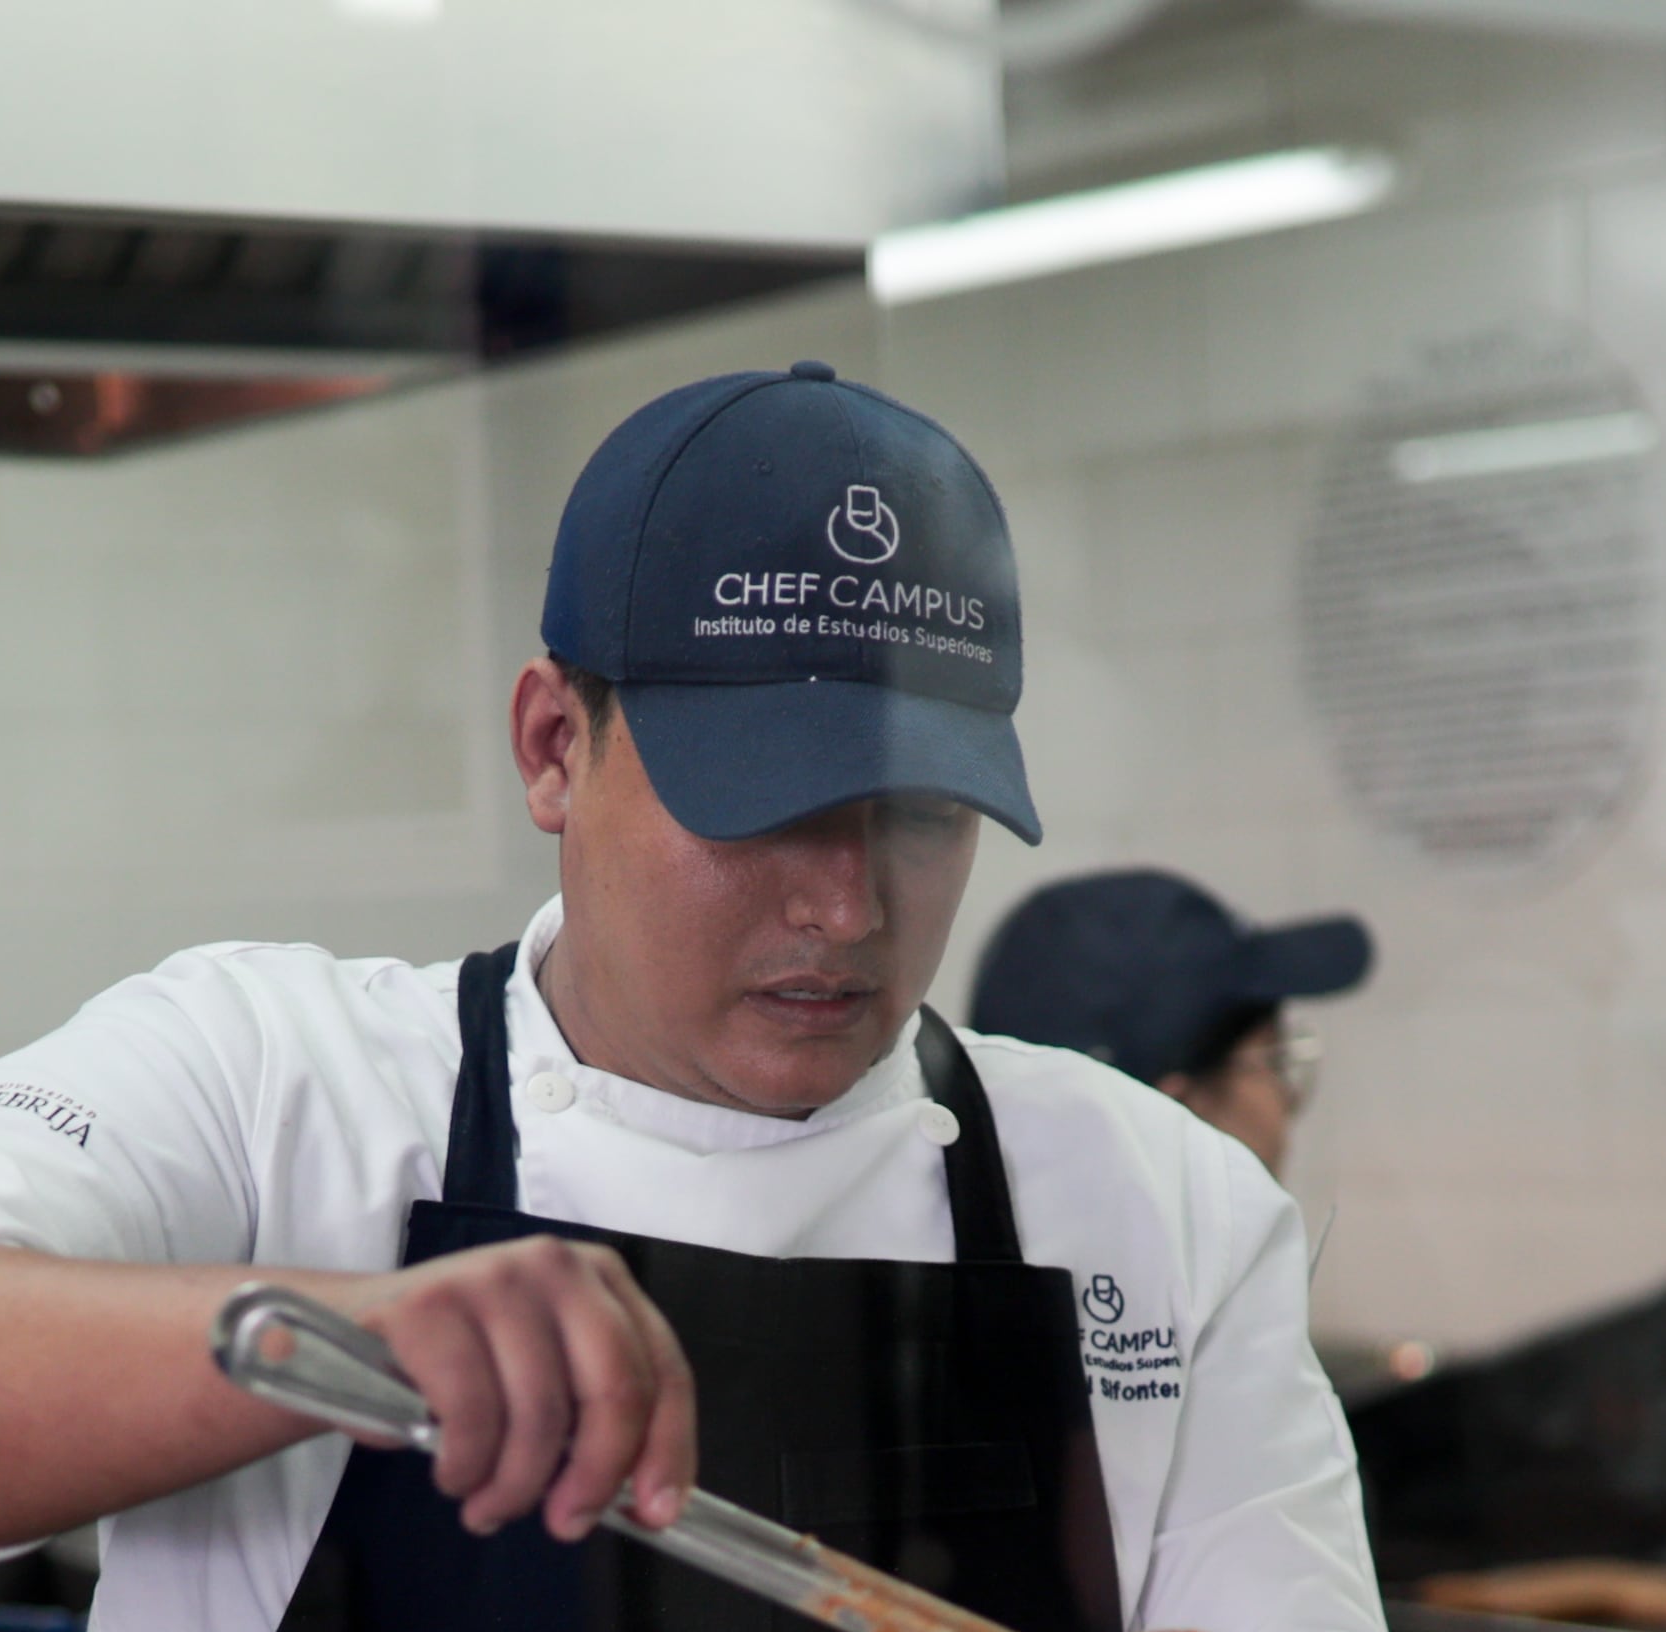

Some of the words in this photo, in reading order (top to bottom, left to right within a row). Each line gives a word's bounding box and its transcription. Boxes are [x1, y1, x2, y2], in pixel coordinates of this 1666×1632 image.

[714, 572, 821, 606] CHEF
[829, 575, 986, 631] CAMPUS
[694, 615, 776, 638] Instituto
[783, 613, 811, 635] de
[817, 614, 910, 645] Estudios
[914, 626, 995, 665] Superiores
[1091, 1327, 1175, 1354] CAMPU
[1085, 1353, 1134, 1372] Estudios
